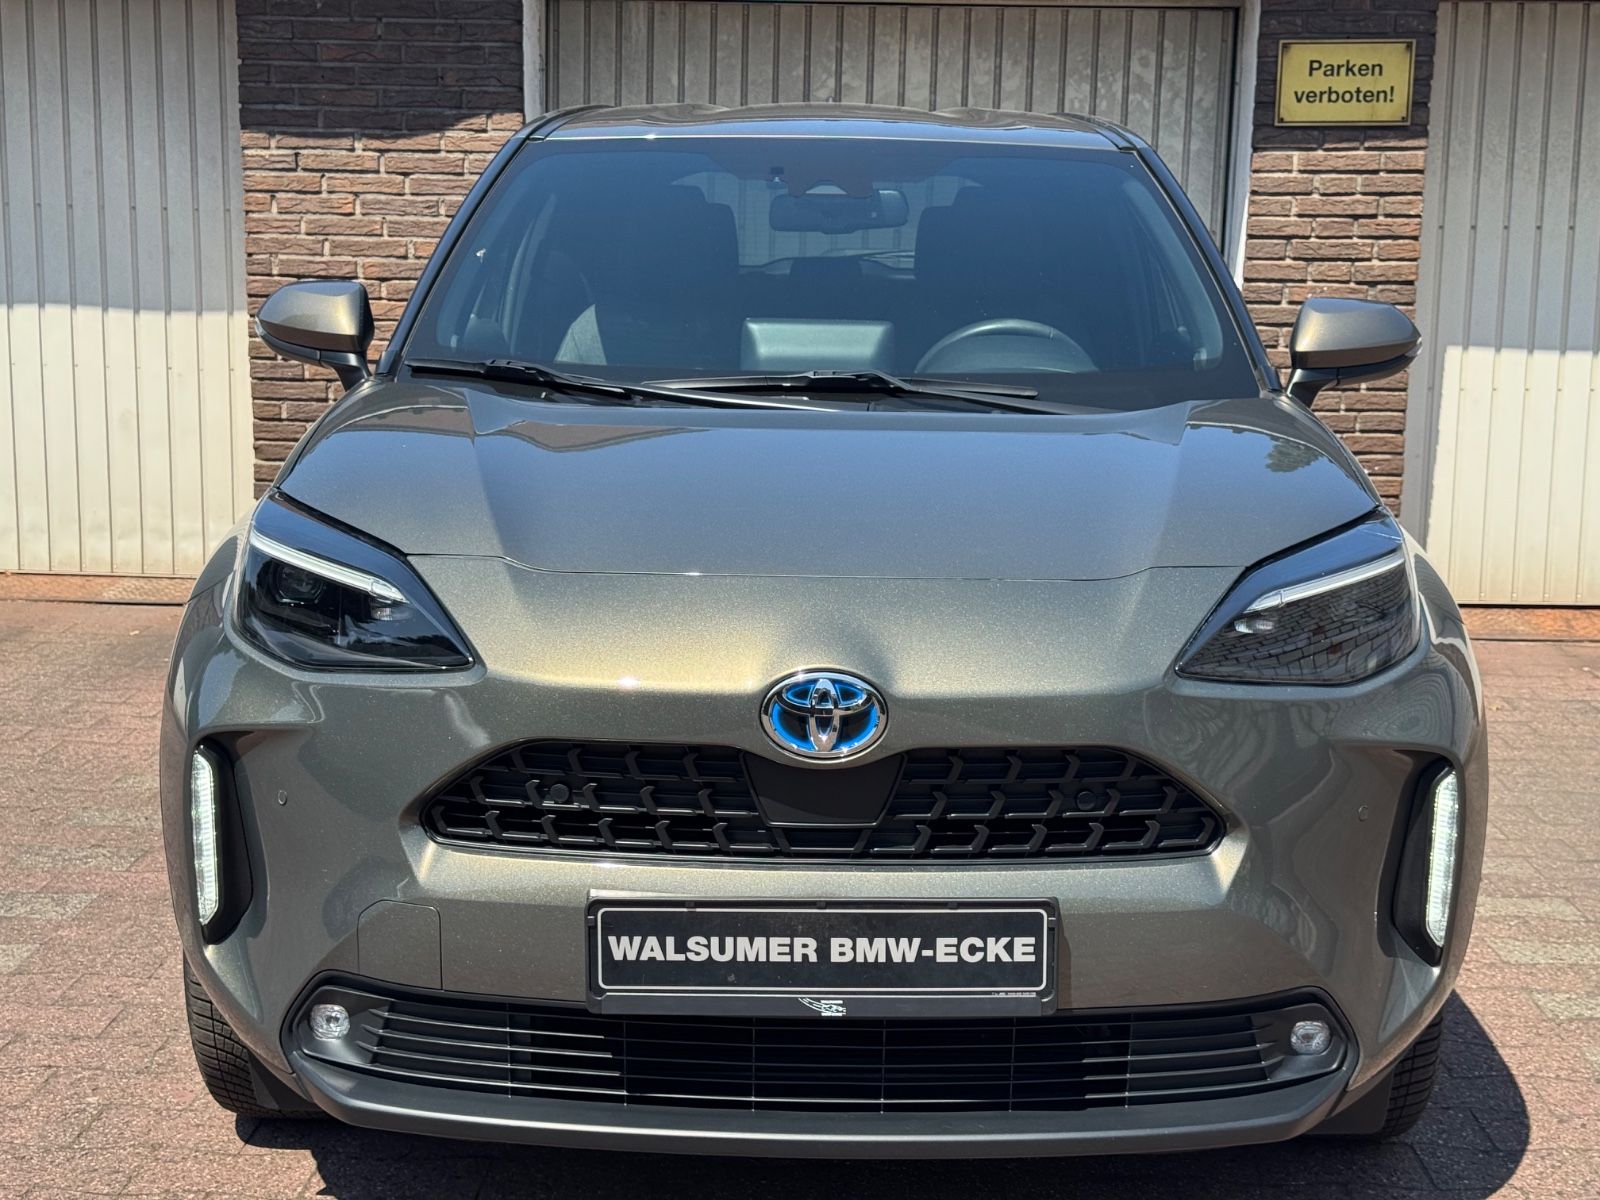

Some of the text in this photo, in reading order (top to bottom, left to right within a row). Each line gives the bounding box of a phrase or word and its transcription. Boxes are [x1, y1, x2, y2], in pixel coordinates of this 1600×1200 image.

[1308, 59, 1383, 77] Parken
[1294, 85, 1395, 103] verboten!
[607, 936, 1037, 963] WALSUMER BMW-ECKE
